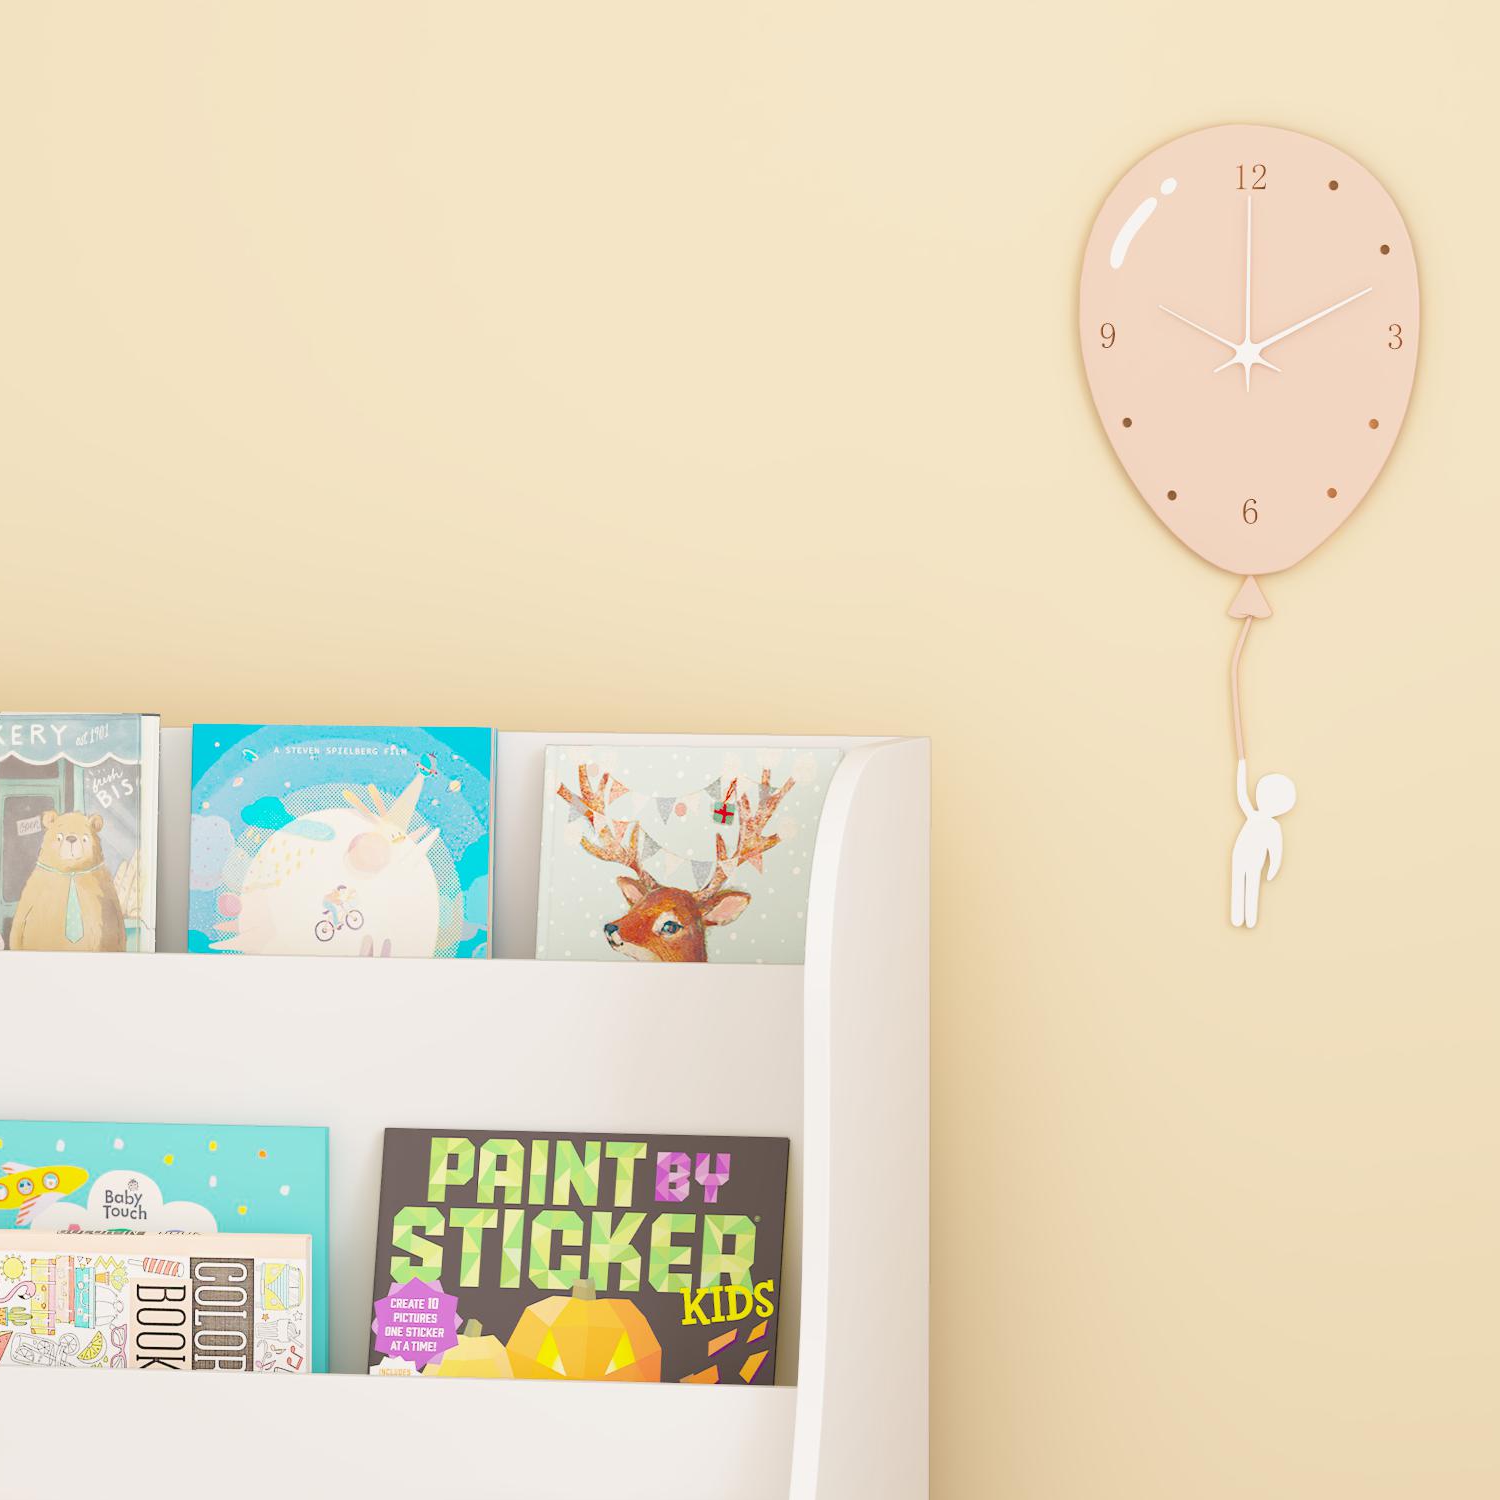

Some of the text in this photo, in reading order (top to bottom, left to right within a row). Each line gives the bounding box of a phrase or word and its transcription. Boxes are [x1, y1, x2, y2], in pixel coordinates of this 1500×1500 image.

[1235, 163, 1268, 190] 12
[1100, 322, 1116, 349] 9
[1387, 323, 1404, 351] 3
[1242, 498, 1258, 525] 6
[326, 747, 378, 755] SPIELBERG
[384, 748, 408, 756] FILM
[96, 777, 138, 808] BIS
[427, 1136, 731, 1208] PAINT BY
[102, 1204, 147, 1220] Touch
[104, 1189, 143, 1208] Baby
[389, 1206, 757, 1295] STICKER
[390, 1297, 439, 1309] CREATE 10
[679, 1279, 775, 1327] KIDS
[393, 1312, 438, 1324] PICTURES
[384, 1326, 445, 1338] ONE STICKER
[390, 1341, 437, 1352] AT A TIME!
